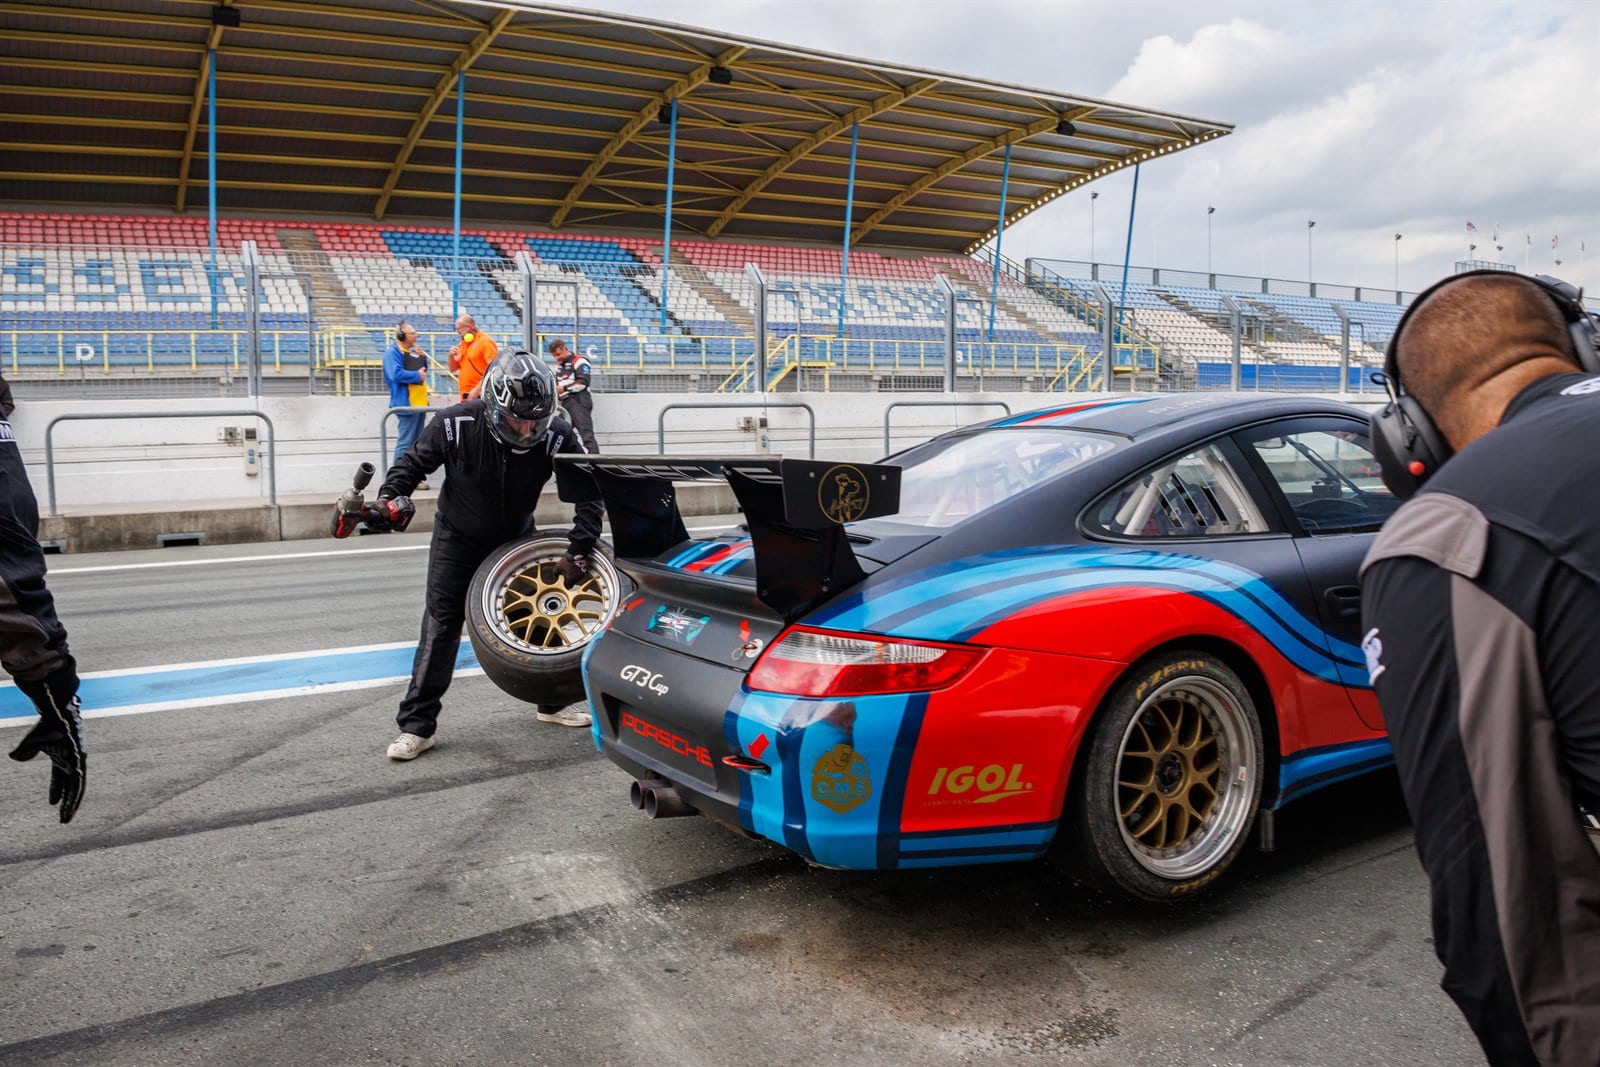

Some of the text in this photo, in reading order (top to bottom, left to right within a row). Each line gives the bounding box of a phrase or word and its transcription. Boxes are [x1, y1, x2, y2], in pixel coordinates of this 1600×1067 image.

[75, 343, 95, 361] D
[586, 344, 598, 359] C
[620, 664, 670, 696] GT3 Cup
[621, 711, 714, 768] PORSCHE
